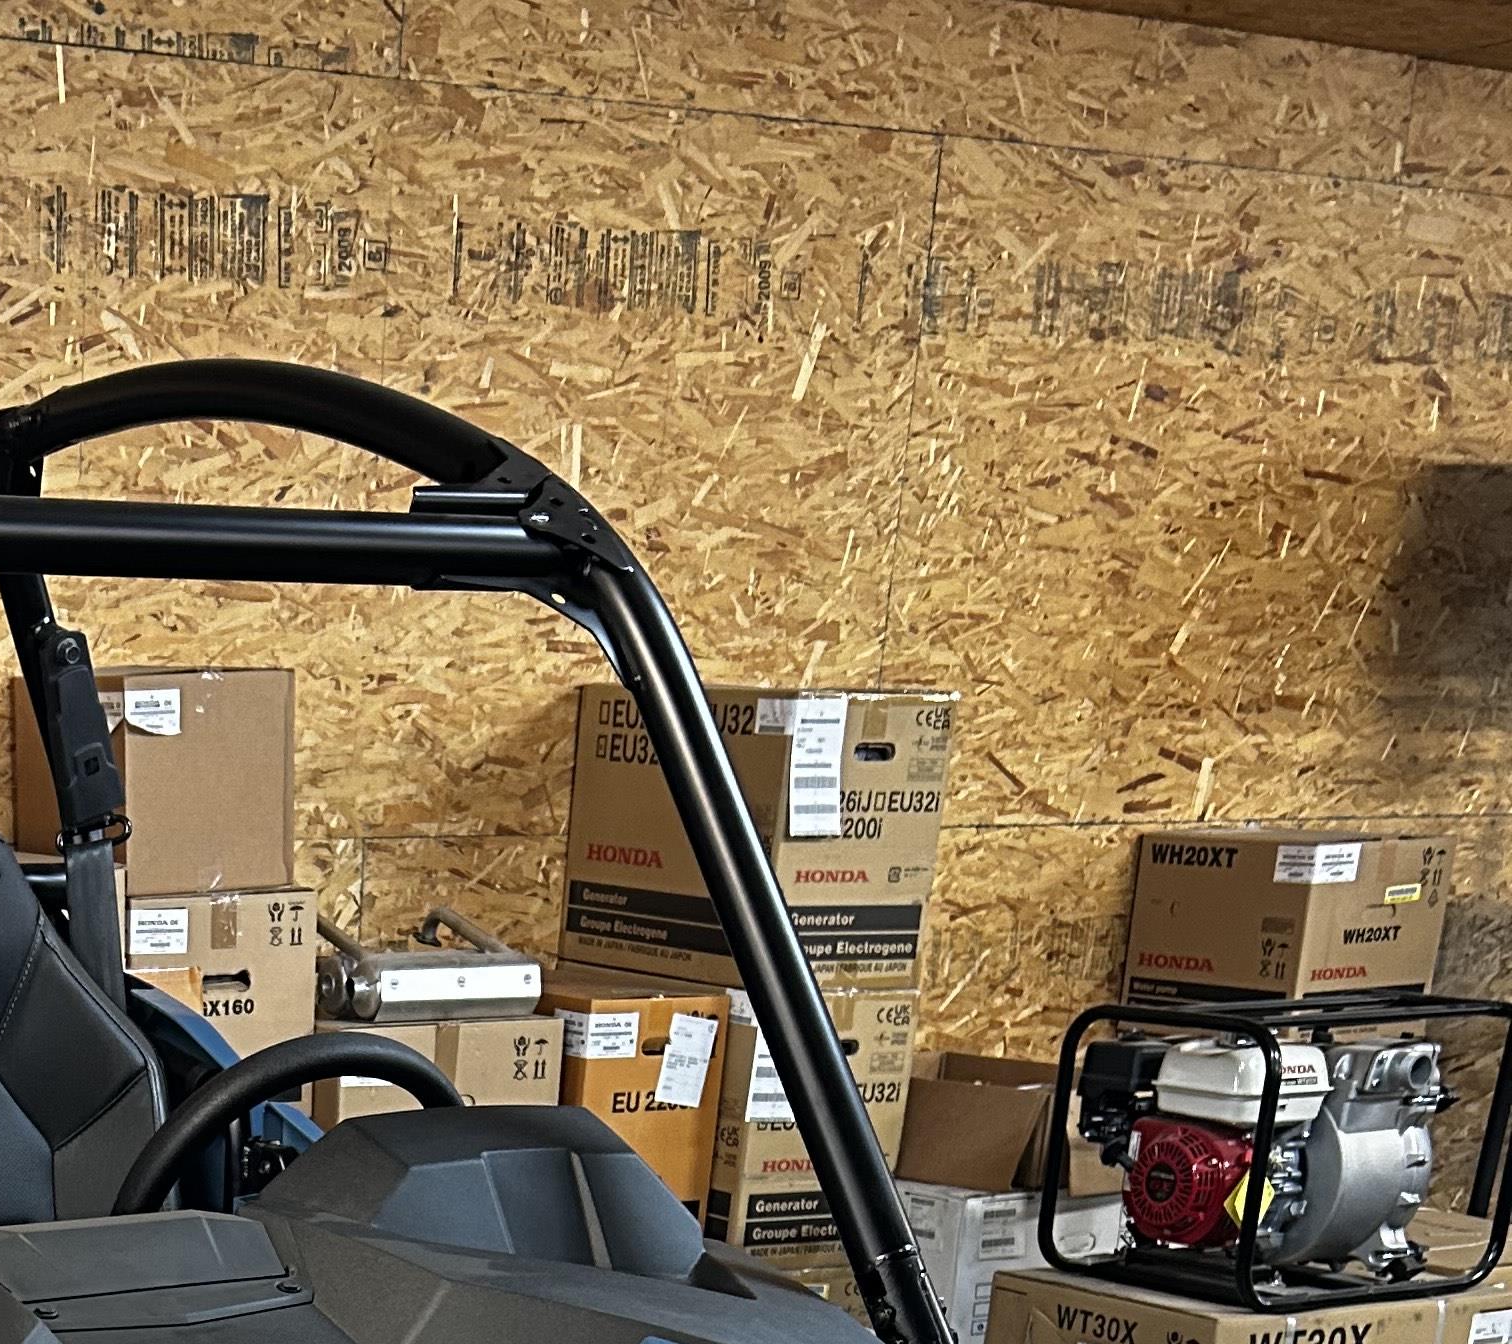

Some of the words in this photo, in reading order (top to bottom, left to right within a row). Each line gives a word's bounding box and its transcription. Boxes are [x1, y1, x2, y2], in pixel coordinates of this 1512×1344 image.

[758, 260, 772, 301] 2009
[587, 843, 664, 869] HONDA
[1151, 842, 1238, 868] WH20XT
[794, 869, 870, 884] HONDA
[582, 888, 629, 906] Generator
[579, 915, 612, 932] Groupe
[613, 919, 669, 941] Electrogene
[1342, 924, 1403, 945] WH20XT
[835, 940, 913, 956] Electrogene
[1138, 952, 1214, 973] HONDA
[1310, 965, 1369, 982] HONDA
[611, 1091, 640, 1114] EU
[755, 1198, 819, 1213] Generator
[752, 1226, 798, 1241] Groupe
